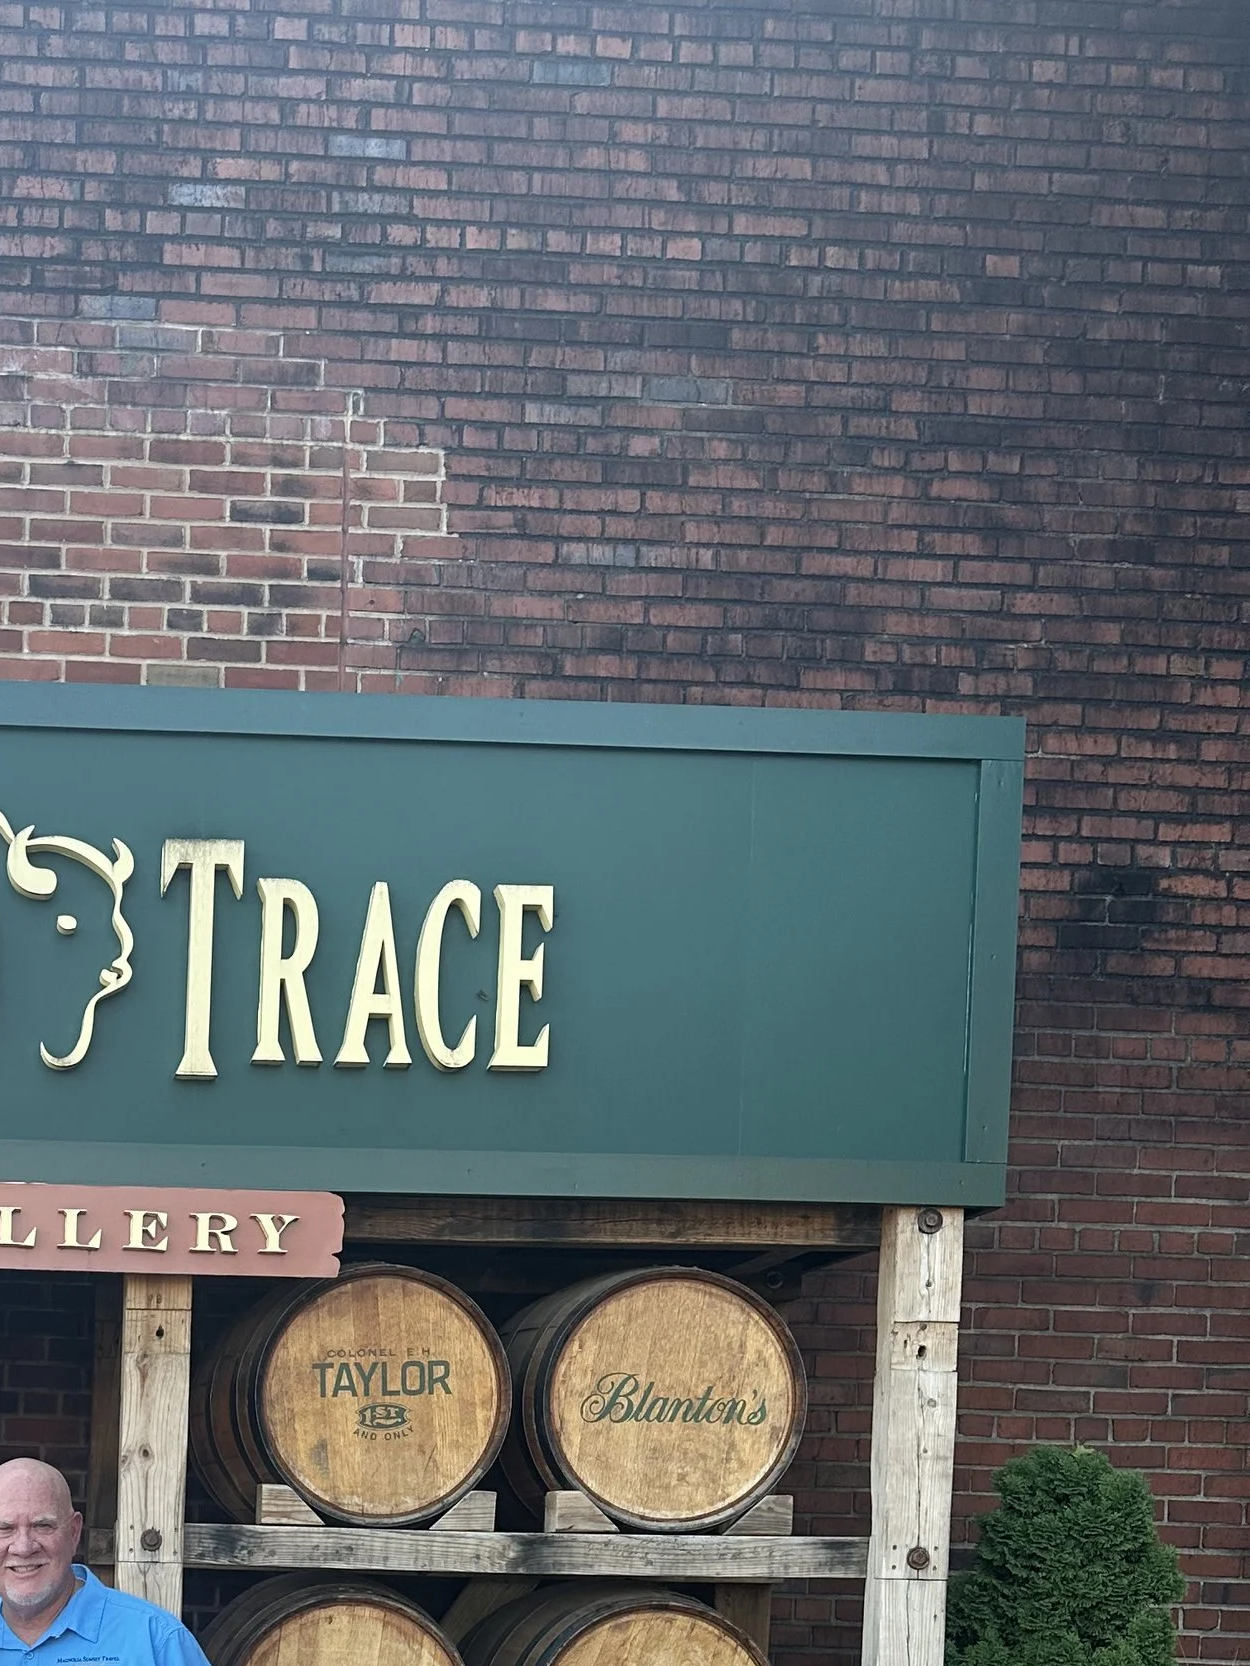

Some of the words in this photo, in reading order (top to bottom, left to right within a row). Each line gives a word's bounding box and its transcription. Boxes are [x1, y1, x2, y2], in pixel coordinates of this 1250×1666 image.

[159, 838, 554, 1080] TRACE
[326, 1348, 397, 1359] COLONEL
[312, 1360, 452, 1398] TAYLOR
[580, 1372, 767, 1425] Blanton's
[352, 1429, 378, 1441] AND
[384, 1425, 415, 1441] ONLY
